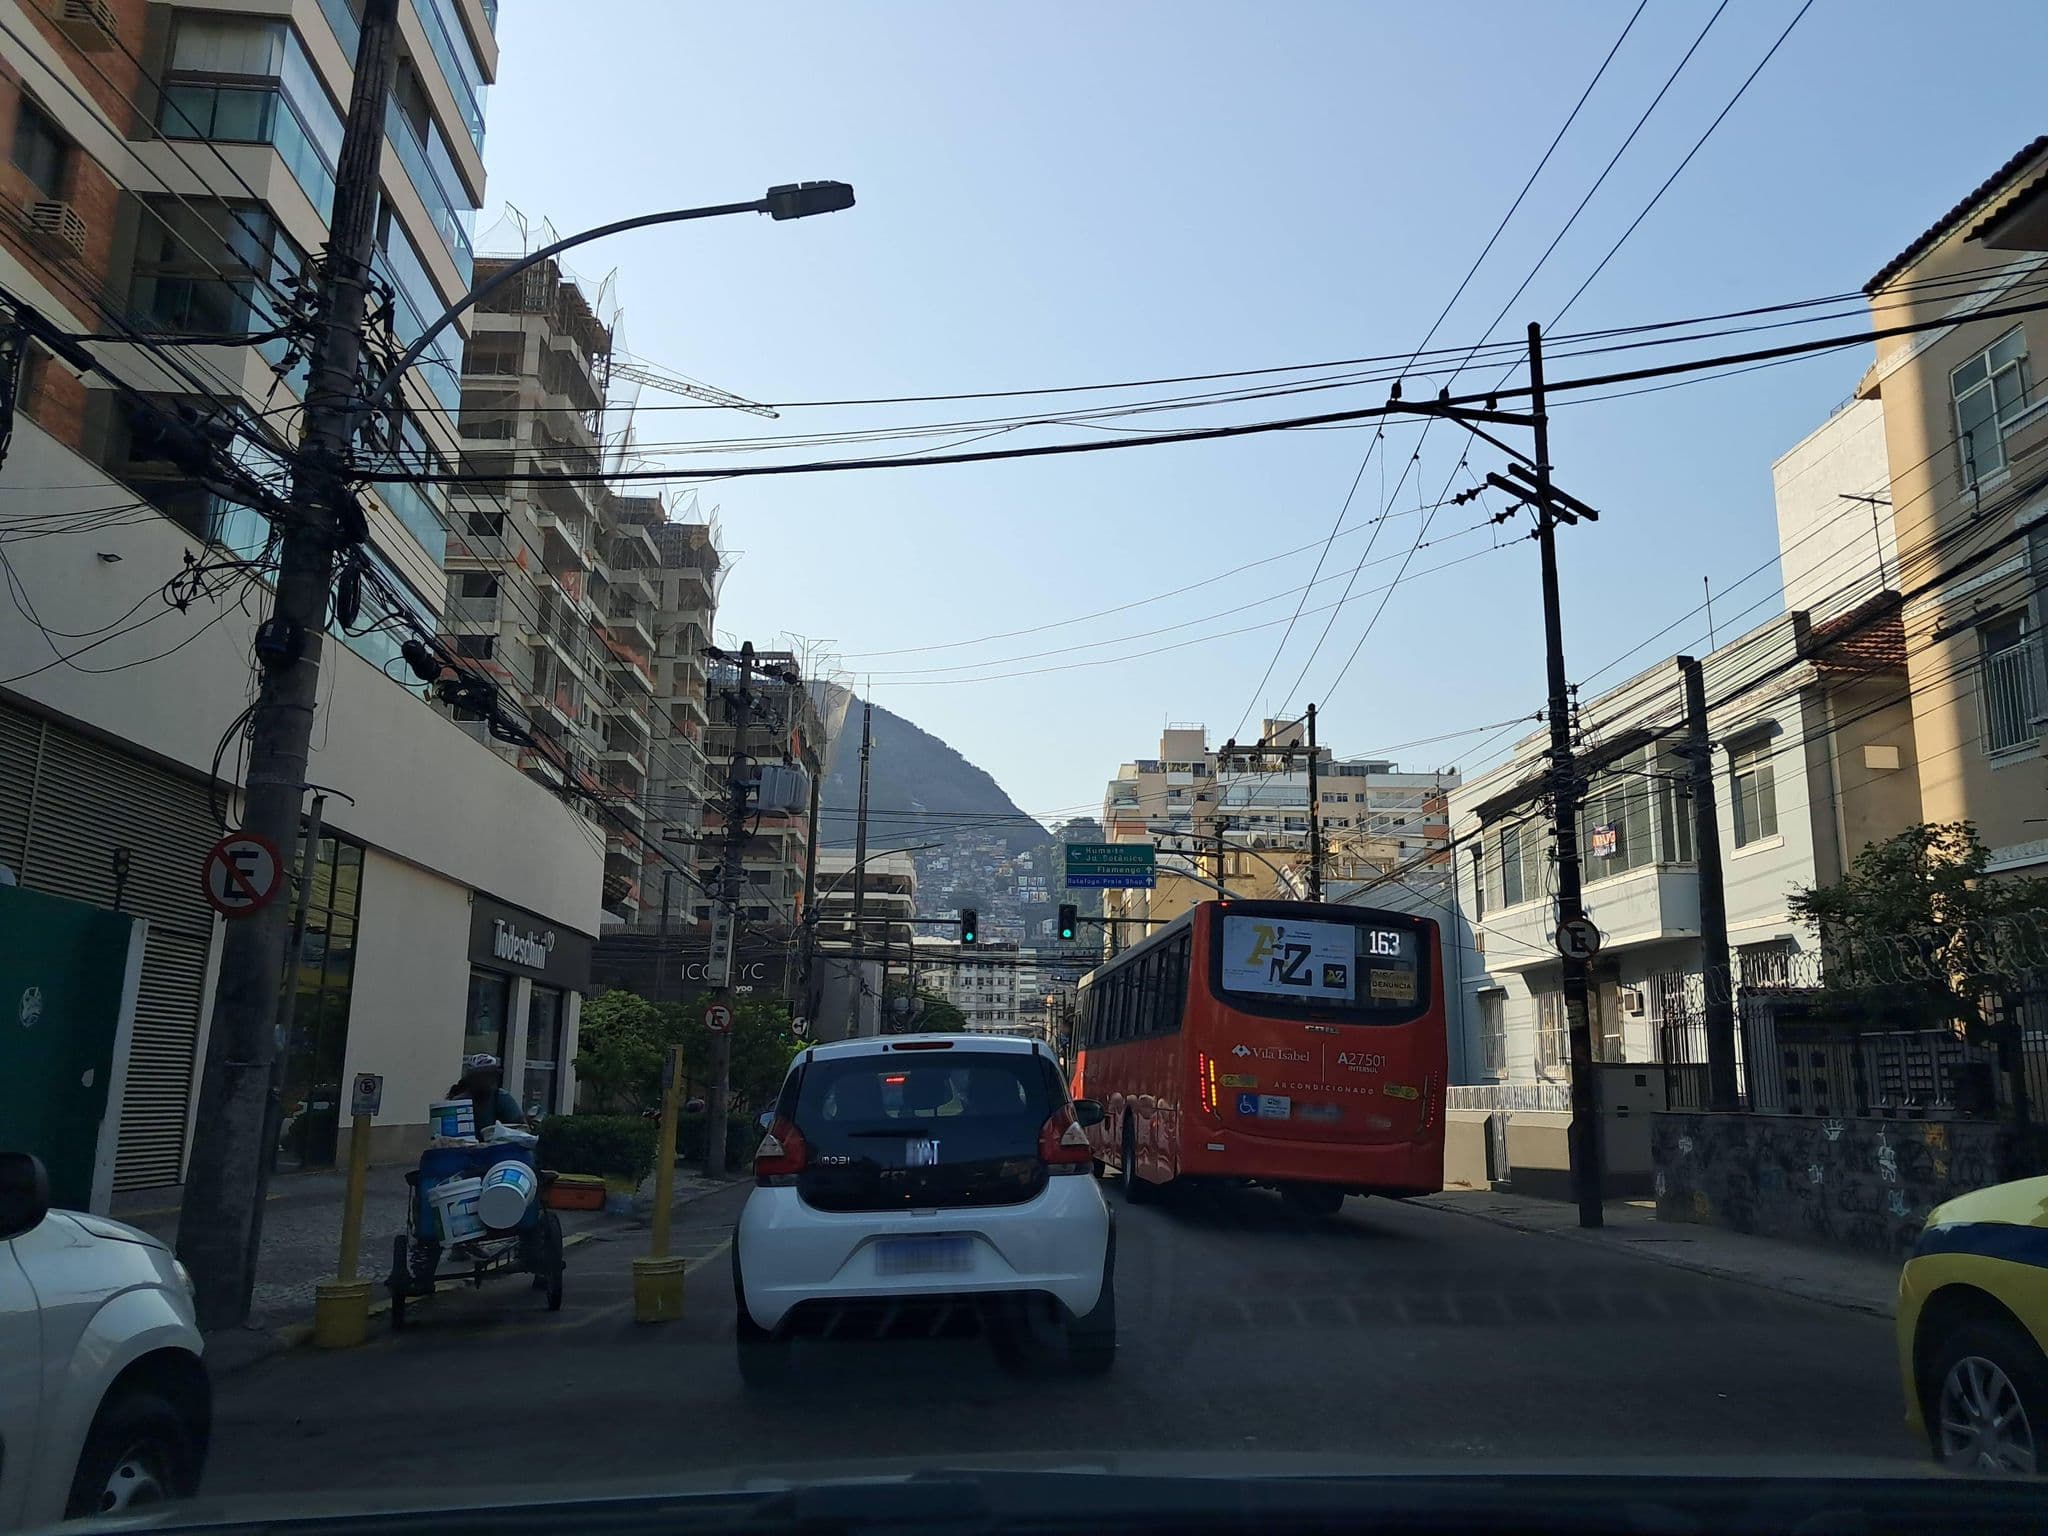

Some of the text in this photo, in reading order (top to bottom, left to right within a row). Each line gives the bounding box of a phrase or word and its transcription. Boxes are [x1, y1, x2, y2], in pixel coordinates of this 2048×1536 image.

[1097, 866, 1141, 875] Flamengo
[494, 919, 547, 969] Todeschini
[1369, 930, 1400, 956] 163
[1372, 980, 1411, 989] DENUNCIA
[1253, 1047, 1310, 1062] Vila Isabel
[1337, 1051, 1386, 1068] A27501
[1347, 1065, 1378, 1074] INTERSUL
